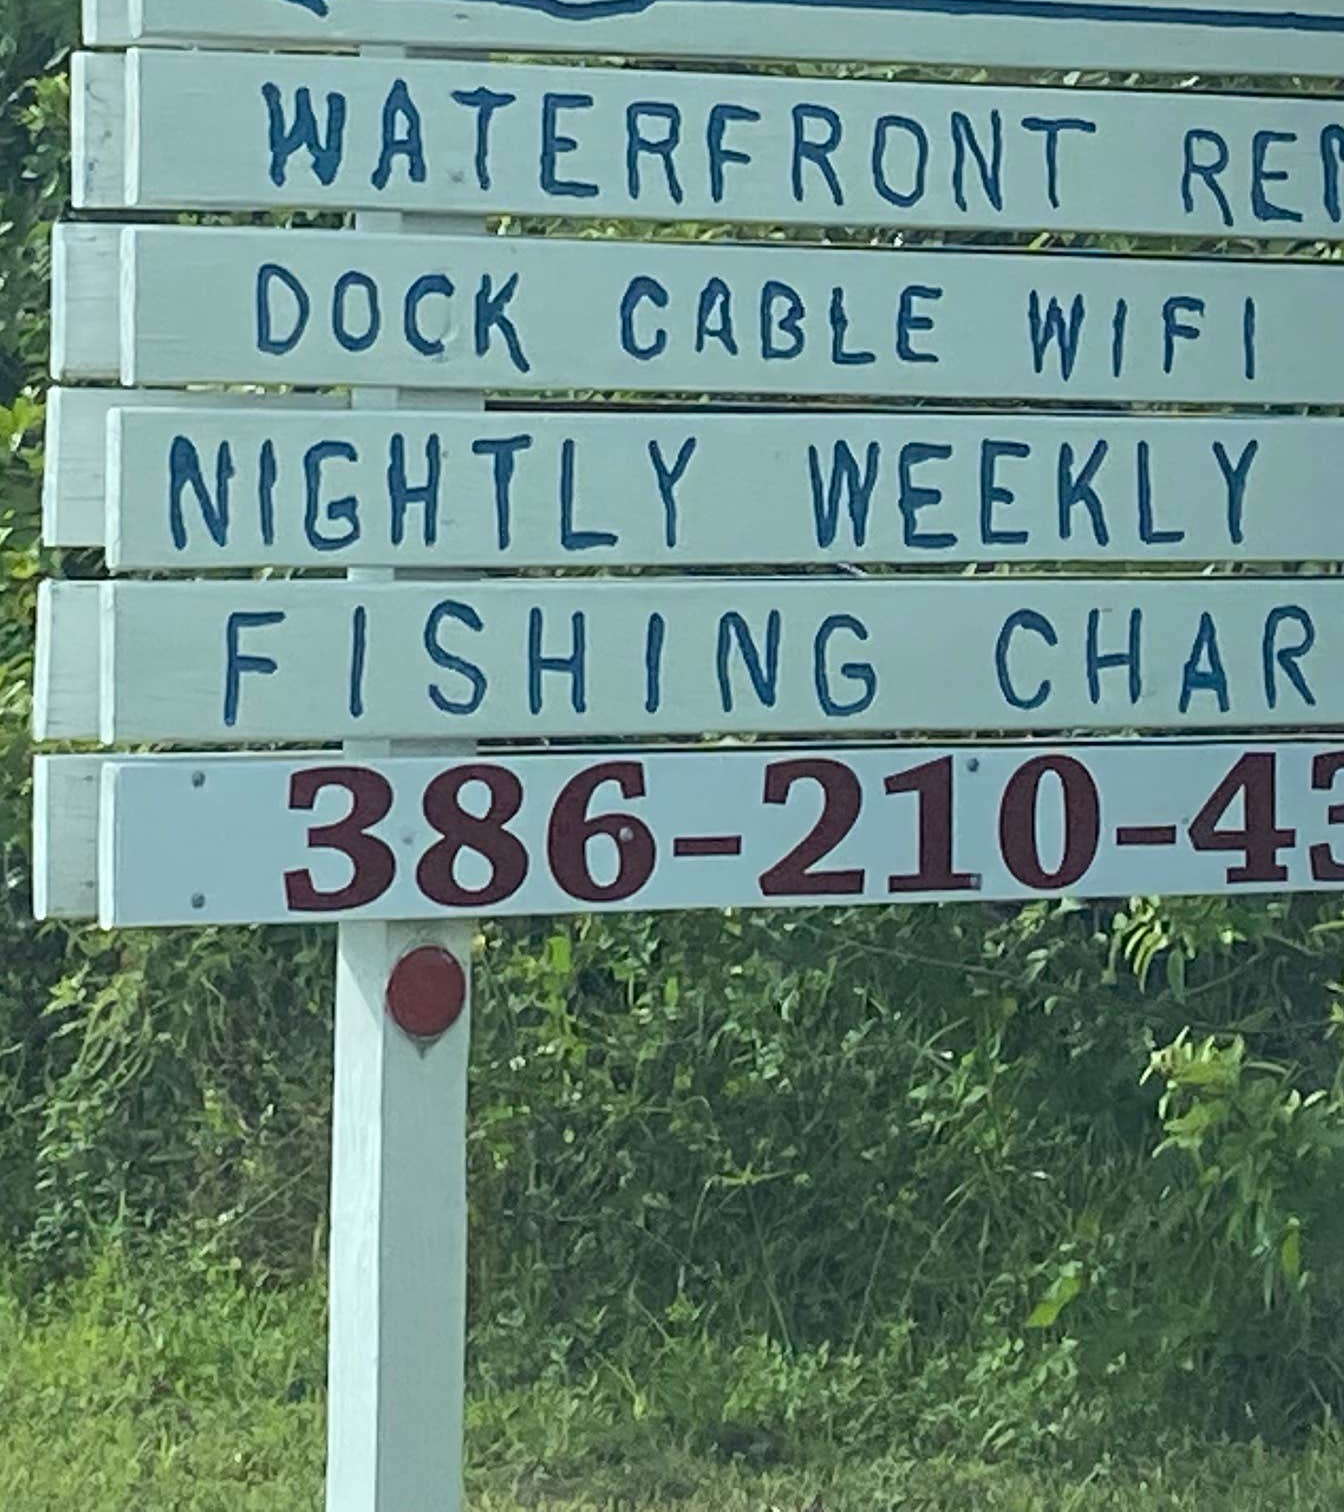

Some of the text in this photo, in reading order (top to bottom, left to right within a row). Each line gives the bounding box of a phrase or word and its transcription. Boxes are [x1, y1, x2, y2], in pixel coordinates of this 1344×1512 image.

[261, 78, 1097, 213] WATERFRONT
[256, 263, 531, 373] DOCK
[620, 276, 940, 365] CABLE
[1028, 289, 1256, 381] WIFI
[167, 433, 698, 551] NIGHTLY
[808, 438, 1258, 549] WEEKLY
[223, 599, 879, 727] FISHING
